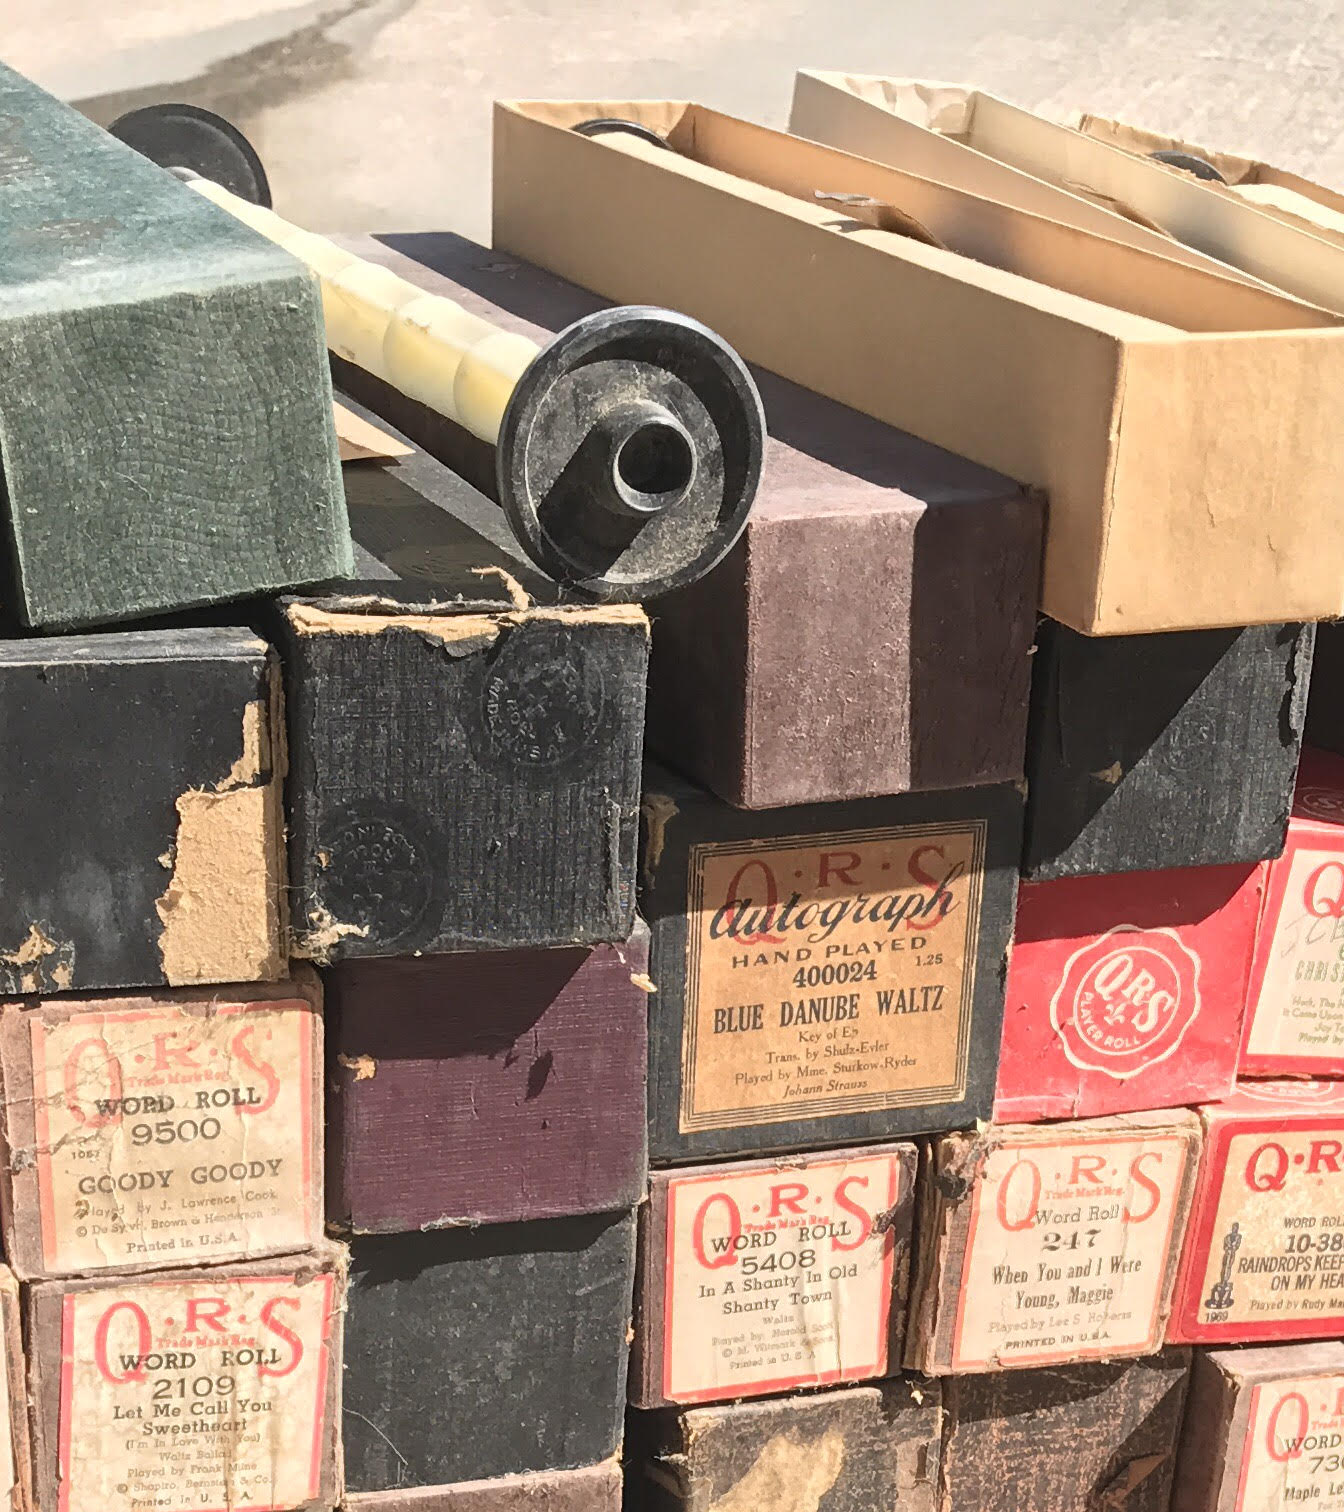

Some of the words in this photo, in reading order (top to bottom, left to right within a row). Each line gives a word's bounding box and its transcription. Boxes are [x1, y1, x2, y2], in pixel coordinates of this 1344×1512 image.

[732, 948, 812, 969] HAND
[825, 937, 927, 959] PLAYED
[915, 953, 944, 966] 1.25
[793, 960, 877, 988] 400024
[714, 1004, 764, 1034] BLUE
[780, 994, 860, 1028] DANUBE
[876, 985, 944, 1017] WALTZ
[799, 1030, 821, 1043] Key
[827, 1028, 838, 1040] of
[783, 1086, 823, 1099] Johann
[826, 1080, 868, 1092] Strauss
[94, 1095, 174, 1117] WORD
[196, 1087, 260, 1108] ROLL
[131, 1117, 221, 1146] 9500
[79, 1170, 174, 1195] GOODY
[191, 1159, 283, 1185] GOODY
[1035, 1208, 1081, 1225] Word
[1087, 1205, 1119, 1221] Roll
[1284, 1217, 1316, 1228] WORD
[712, 1231, 777, 1252] WORD
[799, 1222, 852, 1242] ROLL
[1042, 1229, 1102, 1251] 247
[741, 1249, 816, 1275] 5408
[993, 1263, 1028, 1285] When
[1037, 1262, 1062, 1280] You
[1066, 1261, 1092, 1279] and
[1096, 1258, 1102, 1276] I
[1110, 1256, 1142, 1273] Were
[1238, 1255, 1312, 1273] RAINDROPS
[698, 1285, 715, 1299] In
[724, 1282, 736, 1294] A
[743, 1273, 800, 1293] Shanty
[807, 1271, 822, 1283] In
[829, 1264, 858, 1279] Old
[1271, 1276, 1290, 1291] ON
[1295, 1274, 1315, 1290] MY
[723, 1295, 779, 1315] Shanty
[789, 1290, 832, 1305] Town
[1015, 1291, 1059, 1309] Young,
[1067, 1285, 1113, 1305] Maggie
[1006, 1337, 1056, 1349] PRINTED
[1061, 1335, 1073, 1344] IN
[119, 1352, 196, 1372] WORD
[221, 1349, 281, 1367] ROLL
[153, 1376, 236, 1399] 2109
[113, 1405, 143, 1420] Let
[152, 1404, 181, 1418] Me
[190, 1400, 228, 1415] Call
[235, 1399, 272, 1412] You
[143, 1419, 247, 1436] Sweetheart
[1285, 1434, 1342, 1451] WORD
[128, 1468, 165, 1478] Played
[171, 1467, 184, 1476] by
[191, 1464, 223, 1474] Frank
